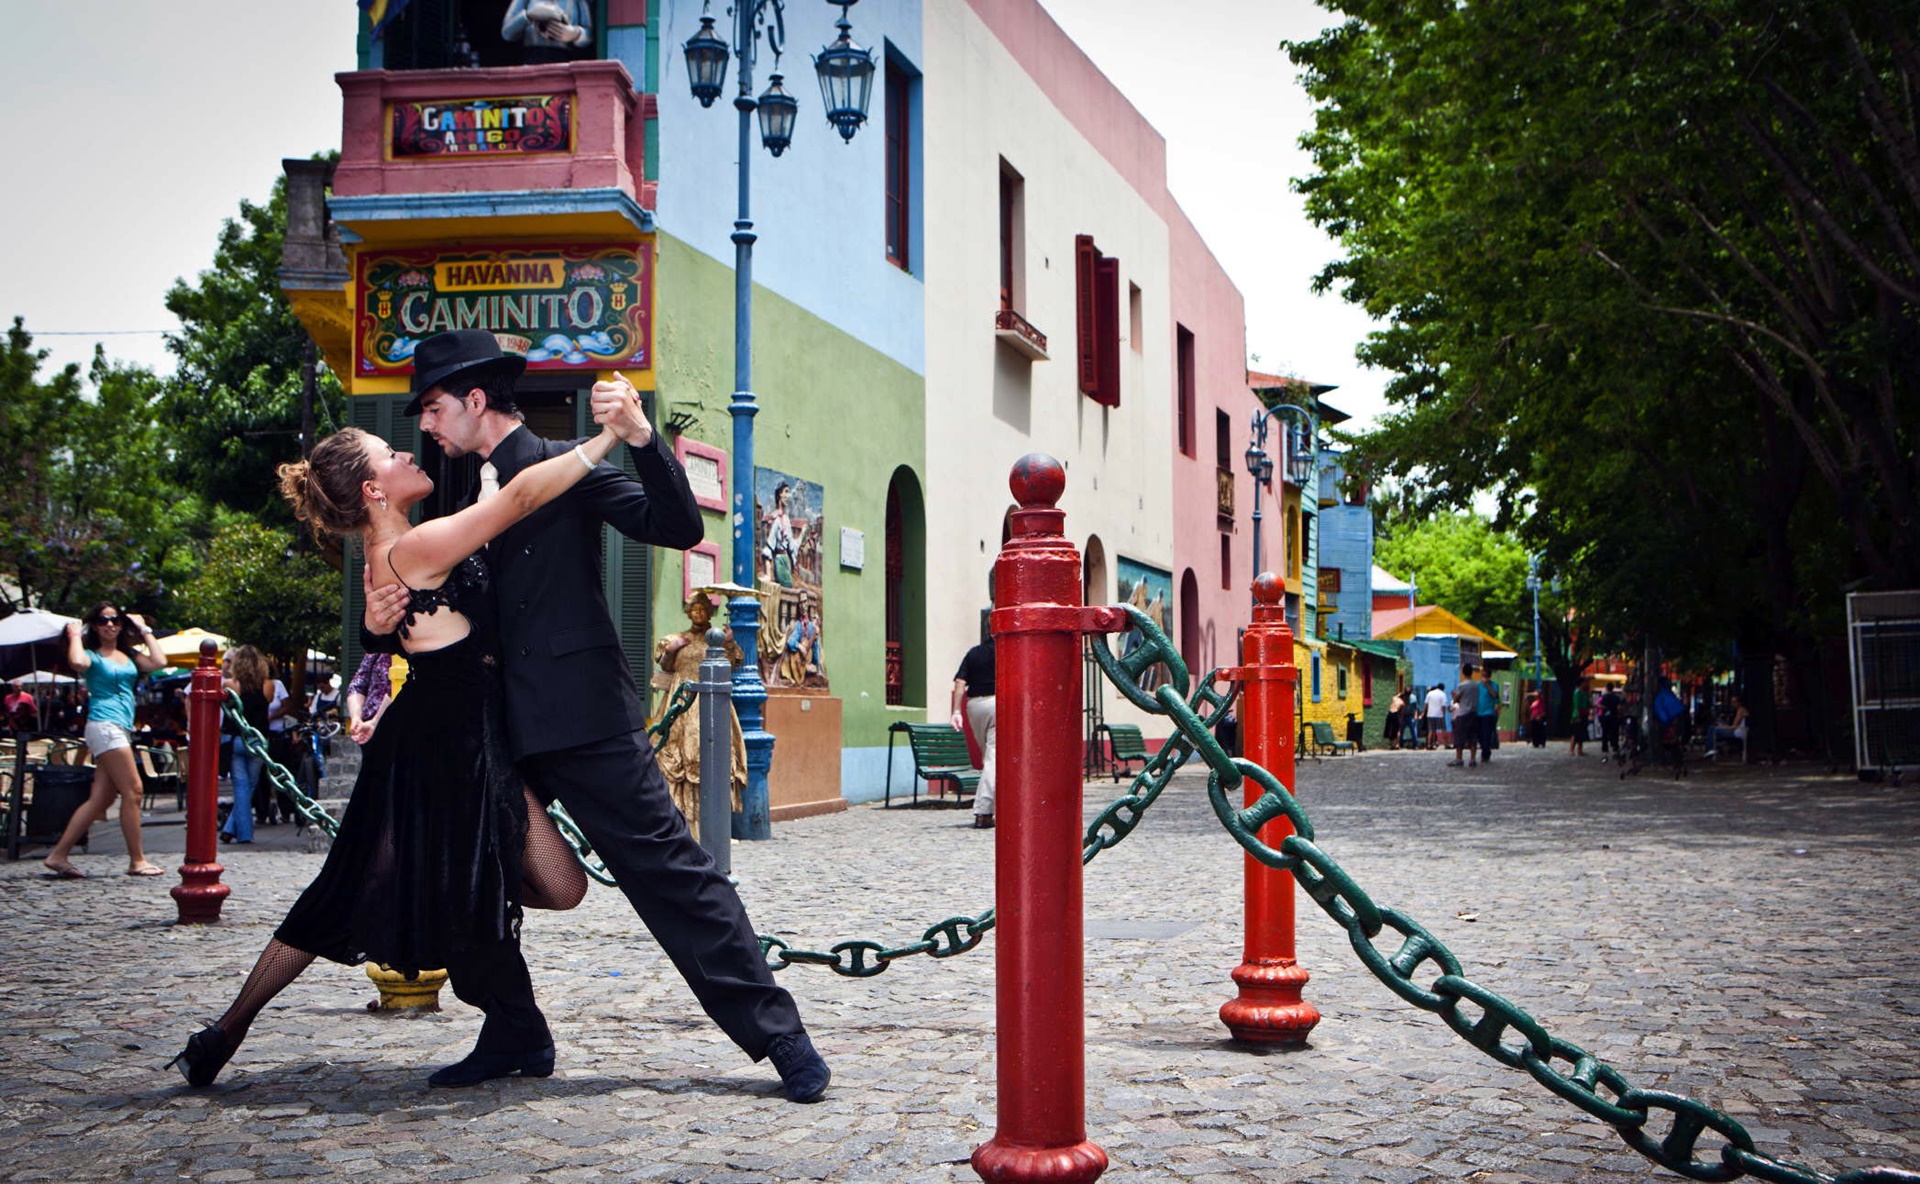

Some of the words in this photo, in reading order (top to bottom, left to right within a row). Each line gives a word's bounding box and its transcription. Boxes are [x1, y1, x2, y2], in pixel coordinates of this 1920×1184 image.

[444, 129, 520, 145] AMIGO
[446, 263, 555, 287] HAVANNA
[614, 294, 623, 308] H
[380, 302, 389, 316] H
[400, 286, 604, 334] CAMINITO
[507, 337, 529, 352] 1948
